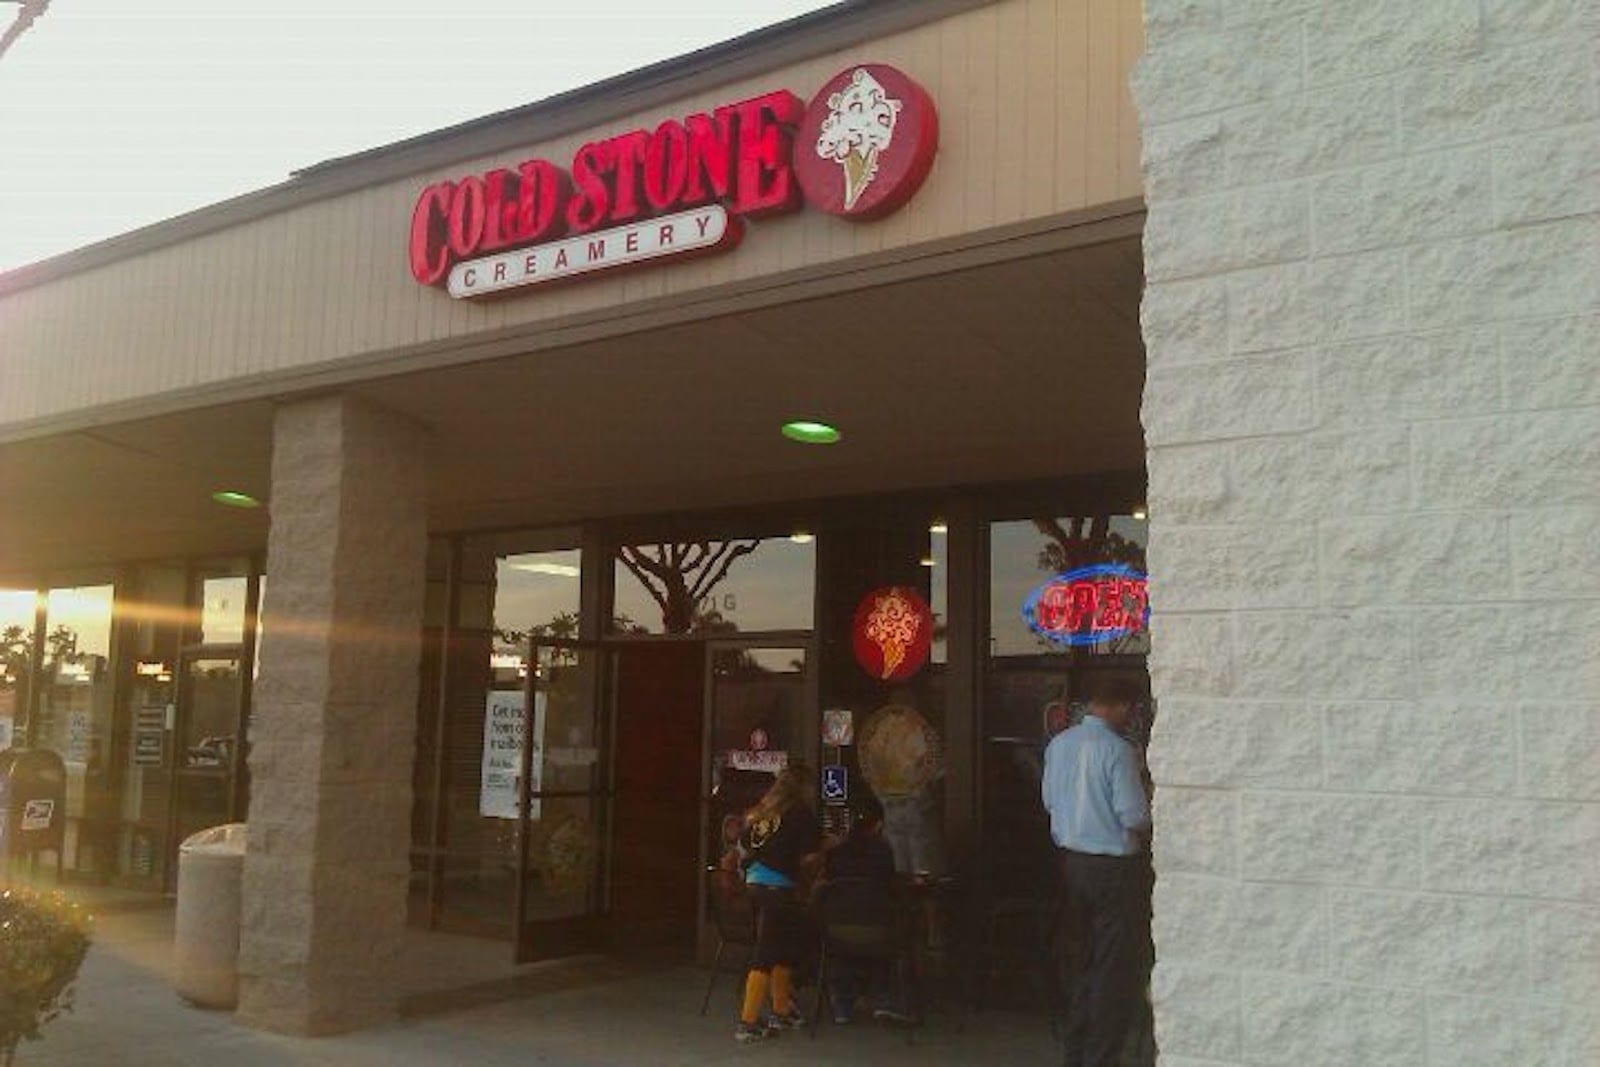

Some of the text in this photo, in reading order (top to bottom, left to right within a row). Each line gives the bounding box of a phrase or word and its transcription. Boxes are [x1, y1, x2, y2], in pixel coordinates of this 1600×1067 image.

[409, 89, 793, 285] COLD STONE
[463, 215, 711, 288] CREAMERY
[1037, 579, 1148, 632] OPEN
